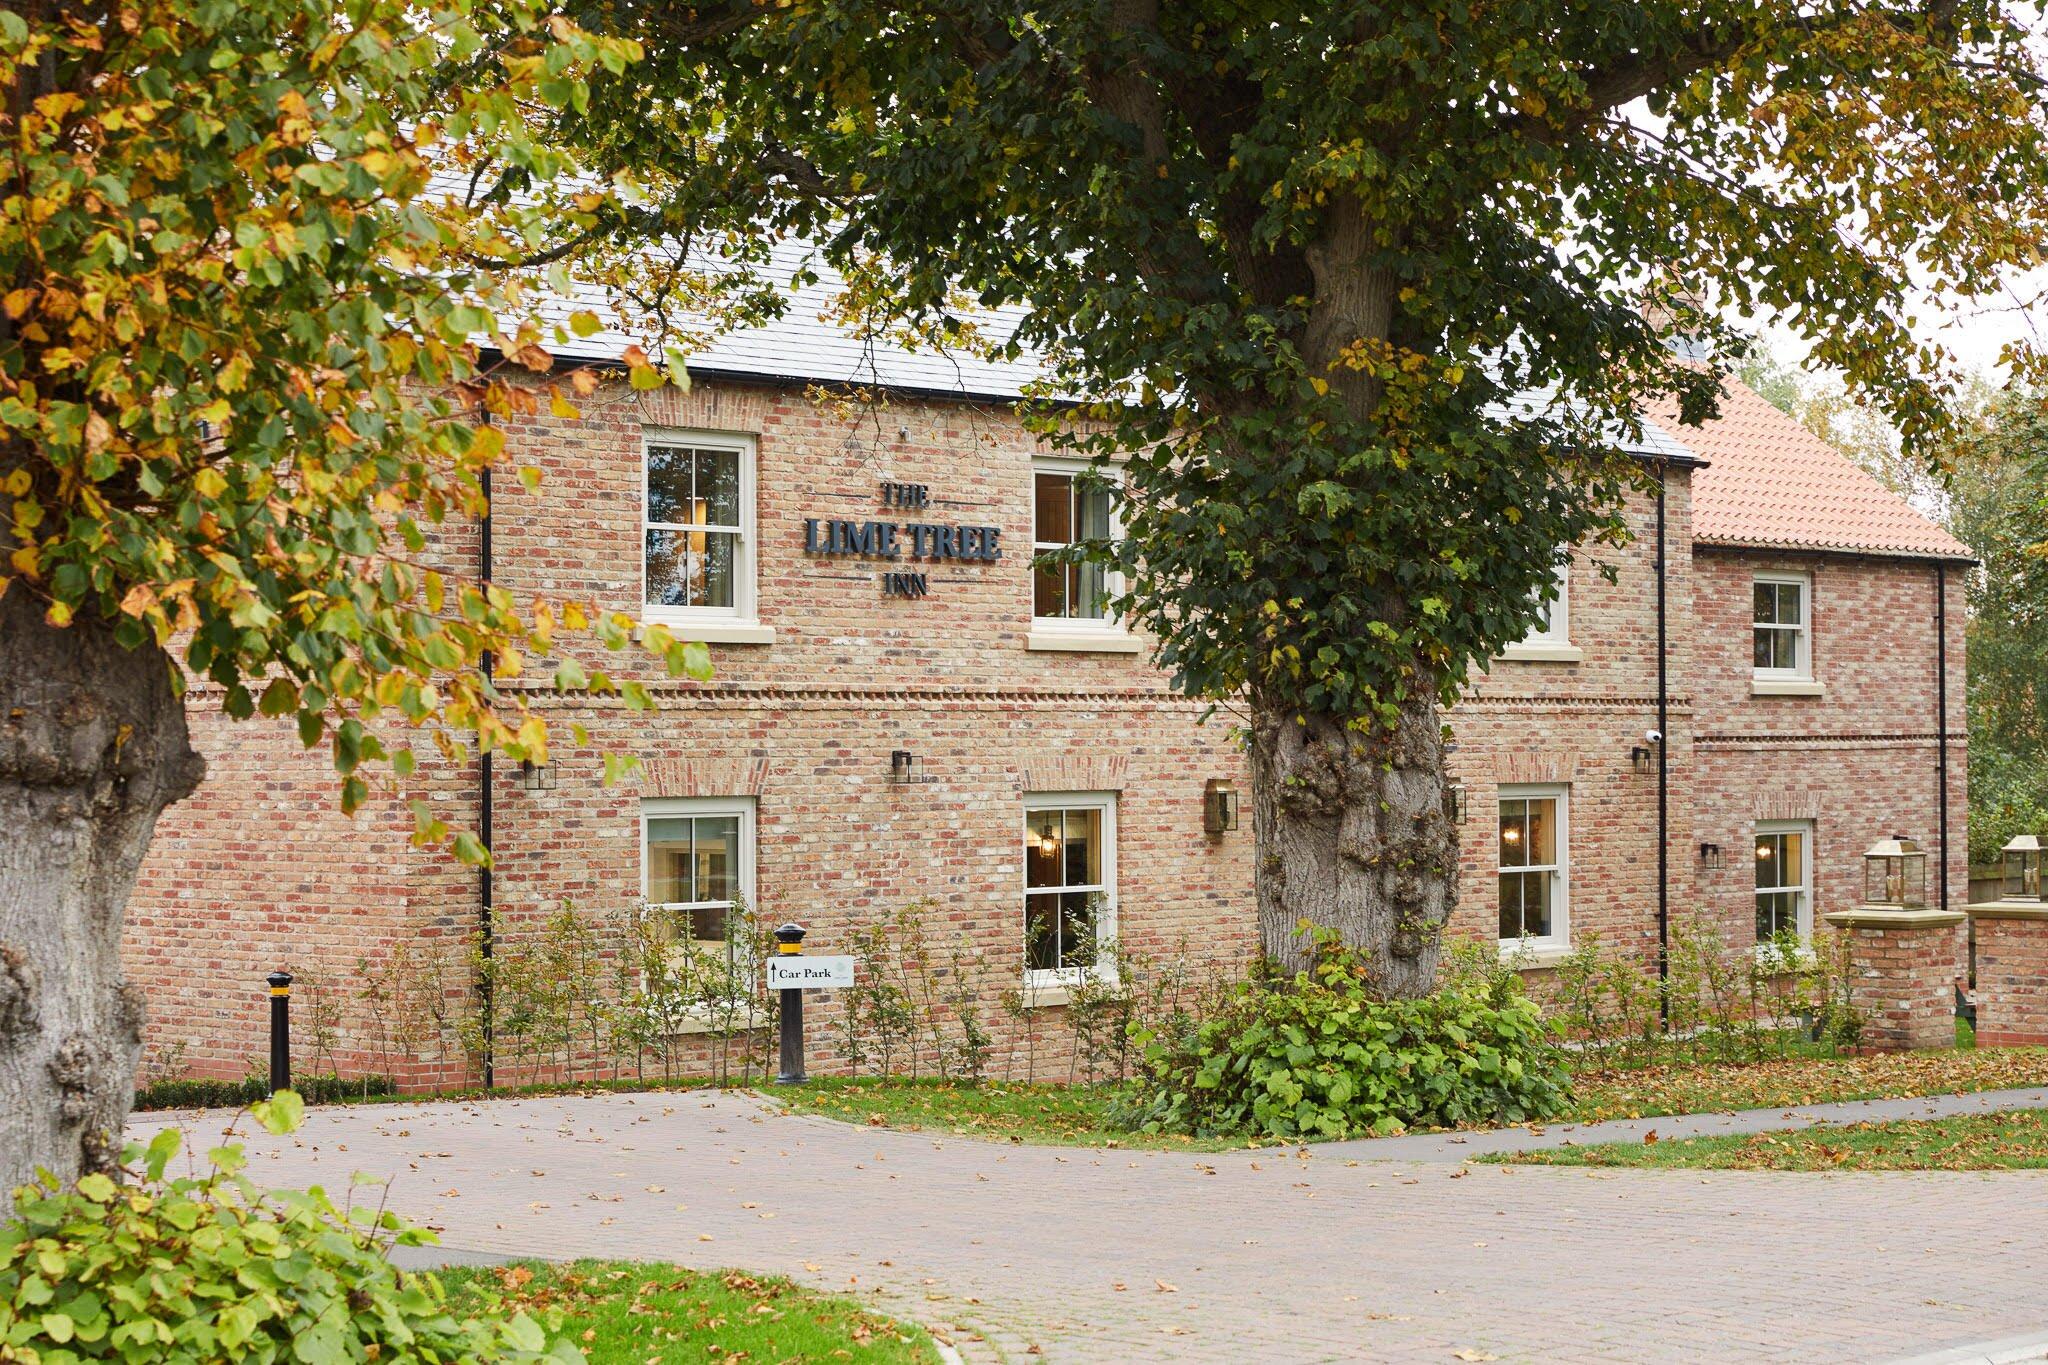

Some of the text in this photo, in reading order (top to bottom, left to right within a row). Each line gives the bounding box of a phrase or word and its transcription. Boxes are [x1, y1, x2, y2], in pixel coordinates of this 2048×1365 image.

[880, 482, 929, 508] THE
[804, 518, 1002, 559] LIME TREE
[883, 572, 927, 595] INN
[779, 969, 801, 979] Car
[804, 968, 832, 979] Park
